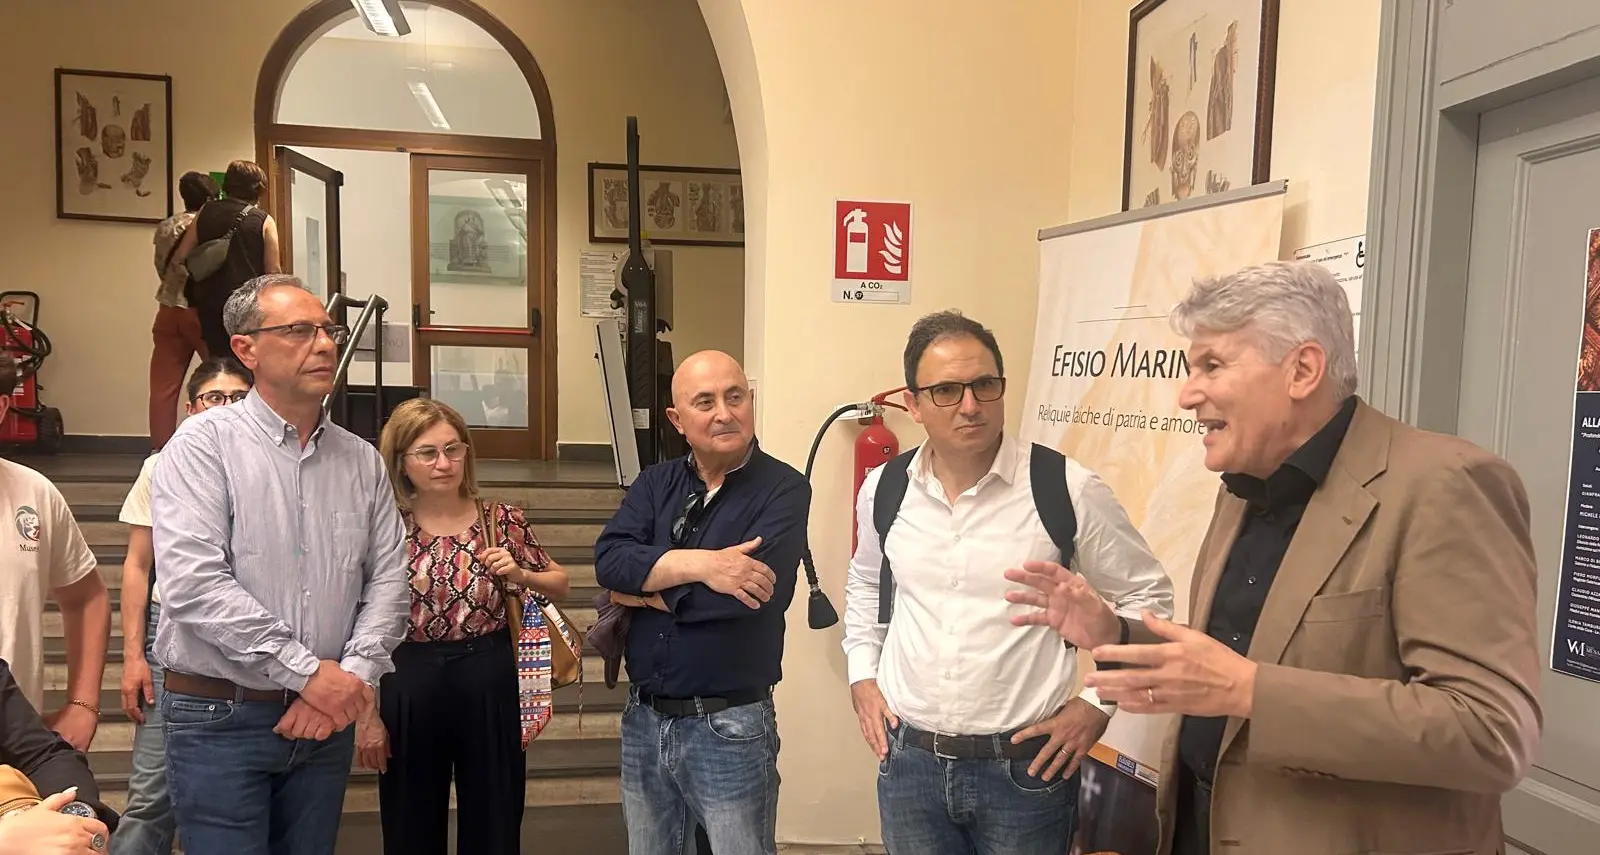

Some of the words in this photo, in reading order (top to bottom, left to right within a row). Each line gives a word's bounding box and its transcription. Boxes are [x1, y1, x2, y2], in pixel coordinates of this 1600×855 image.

[843, 291, 853, 300] N.
[1052, 345, 1106, 377] EFISIO
[1111, 342, 1190, 379] MARIN
[1038, 404, 1071, 425] Reliquie
[1072, 406, 1100, 425] laiche
[1102, 407, 1114, 426] di
[1115, 410, 1147, 432] patria
[1150, 416, 1159, 429] e
[1161, 418, 1206, 434] amore
